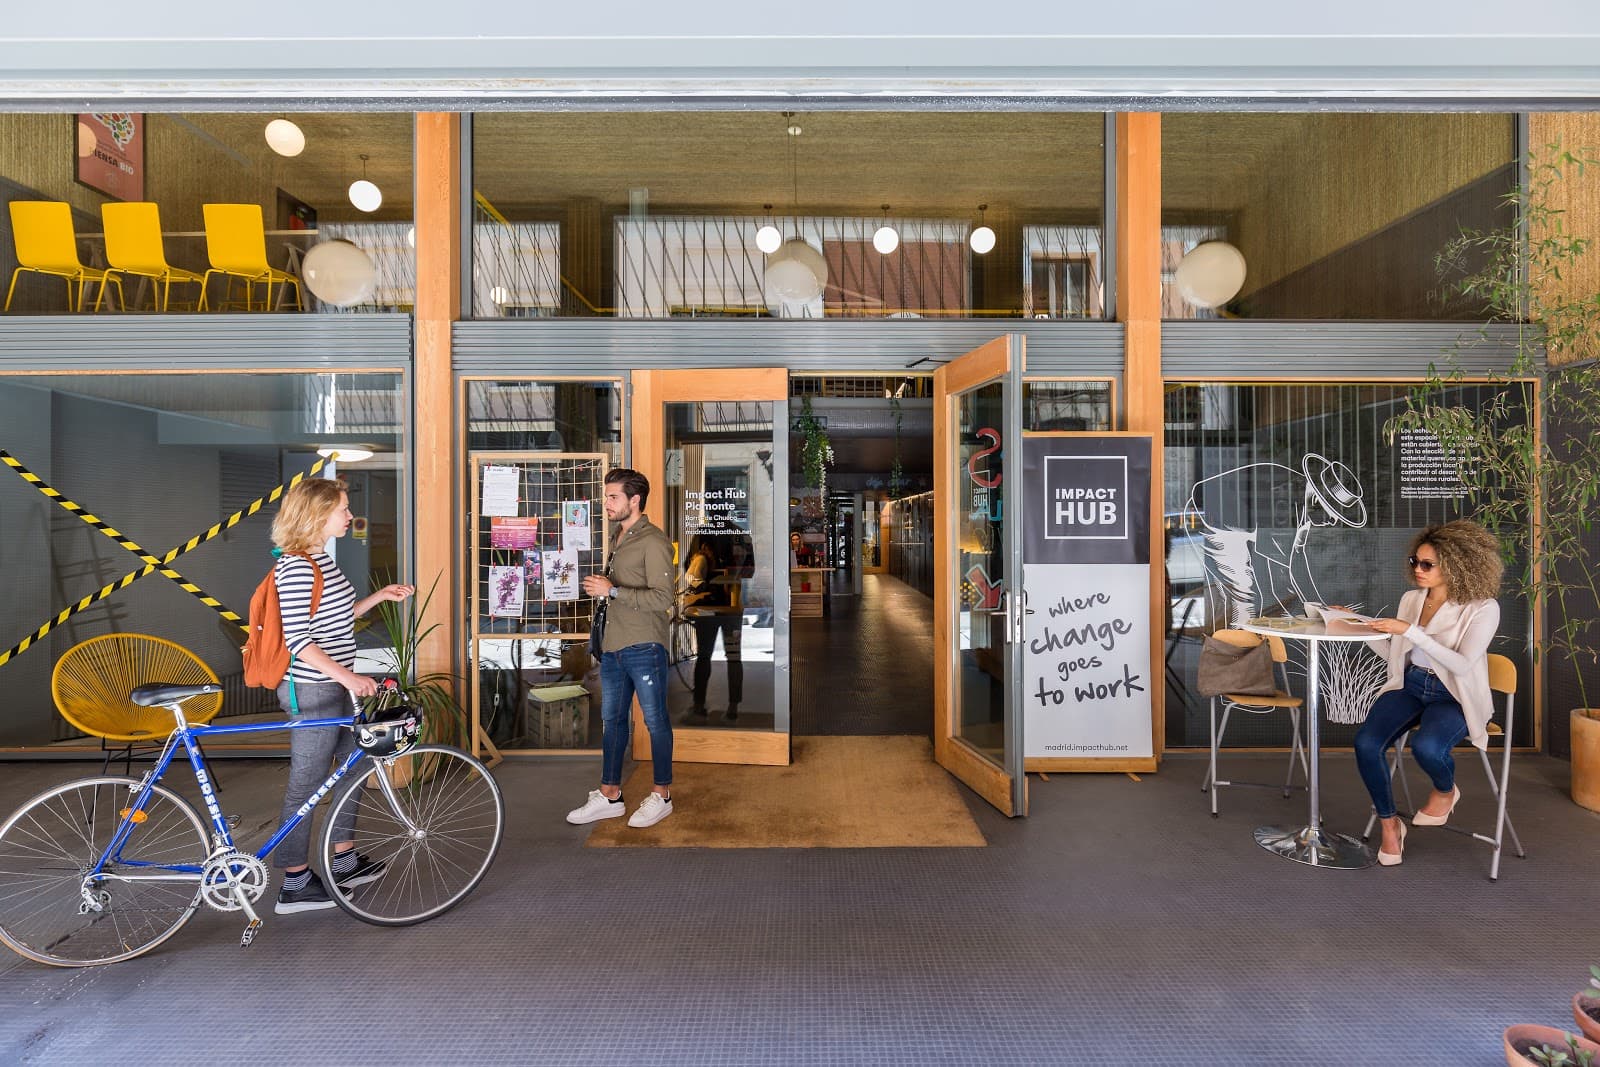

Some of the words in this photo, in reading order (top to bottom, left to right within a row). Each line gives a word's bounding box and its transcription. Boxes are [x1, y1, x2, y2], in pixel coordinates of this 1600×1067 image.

[685, 489, 723, 500] Impact
[725, 489, 747, 499] Hub
[1055, 488, 1117, 500] IMPACT
[685, 501, 736, 511] Piamonte
[1055, 502, 1117, 525] HUB
[1049, 593, 1111, 618] where
[1030, 618, 1133, 655] change
[1057, 655, 1103, 682] goes
[1034, 676, 1065, 707] to
[1074, 663, 1145, 703] work
[1044, 744, 1128, 752] madrid.impacthub.net
